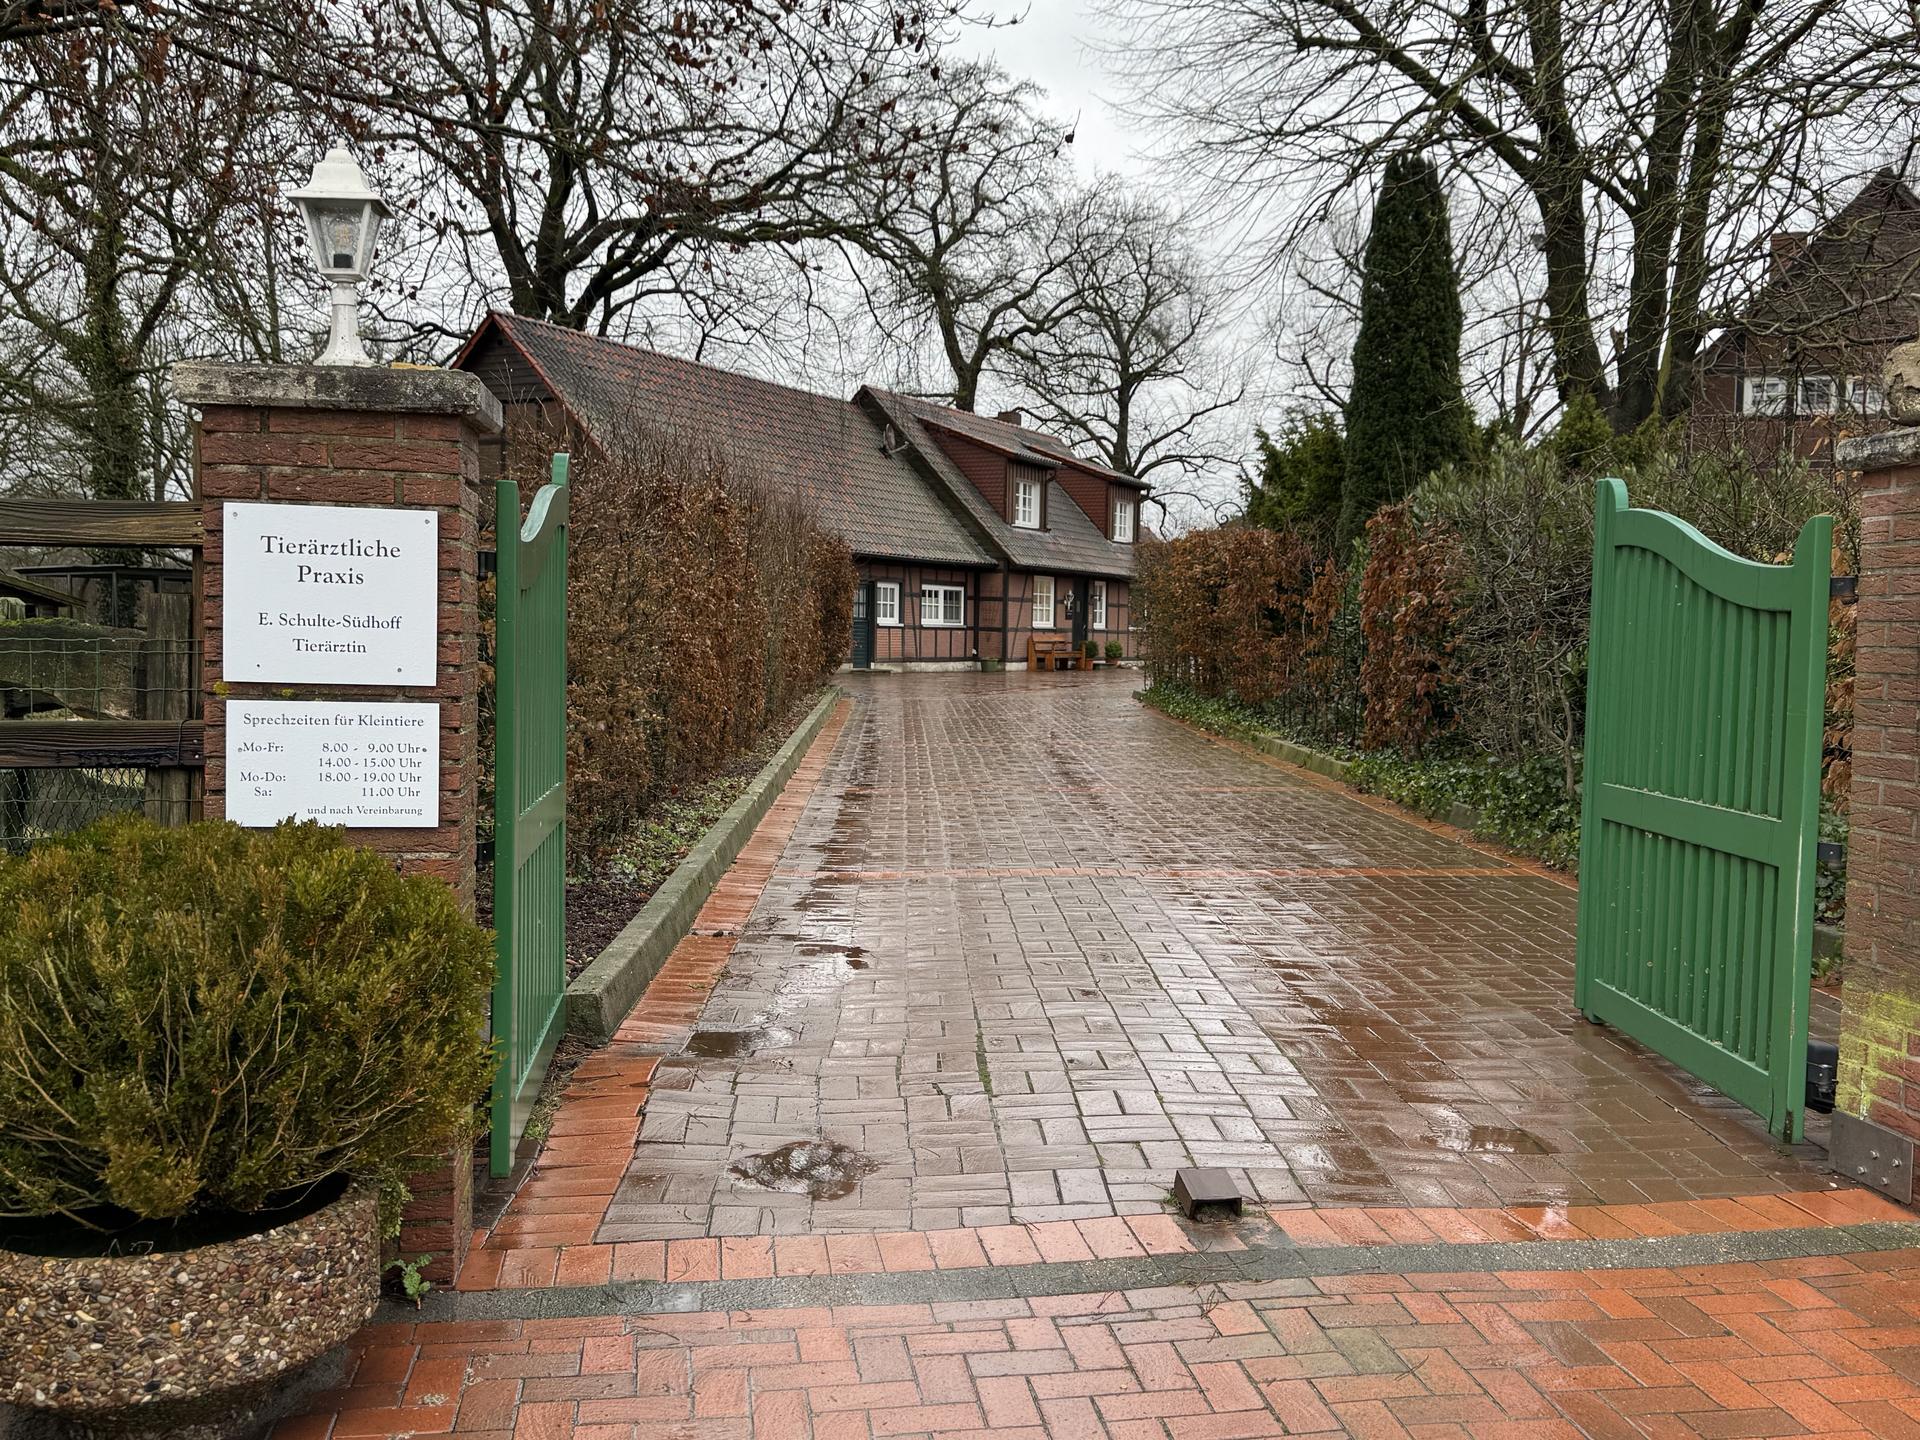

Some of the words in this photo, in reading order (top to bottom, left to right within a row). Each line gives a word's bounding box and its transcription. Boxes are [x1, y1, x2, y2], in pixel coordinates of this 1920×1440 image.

[260, 535, 401, 558] Tierärztliche
[297, 565, 364, 585] Praxis
[258, 612, 273, 626] E.
[278, 612, 402, 629] Schulte-Südhoff
[292, 638, 367, 653] Tierärztin
[243, 713, 330, 727] Sprechzeiten
[334, 714, 354, 726] für
[358, 715, 424, 727] Kleintiere
[243, 742, 284, 753] Mo-Fr:
[322, 743, 349, 753] 8.00
[367, 743, 394, 753] 9.00
[397, 743, 421, 753] Uhr
[319, 757, 351, 768] 14.00
[363, 757, 395, 768] 15.00
[399, 757, 422, 768] Uhr
[240, 772, 286, 782] Mo-Do:
[319, 772, 351, 782] 18.00
[363, 772, 395, 783] 19.00
[399, 772, 422, 783] Uhr
[254, 786, 272, 797] Sa:
[362, 787, 394, 797] 11.00
[398, 787, 421, 797] Uhr
[307, 805, 327, 815] und
[329, 805, 353, 815] nach
[356, 805, 423, 816] Vereinbarung
